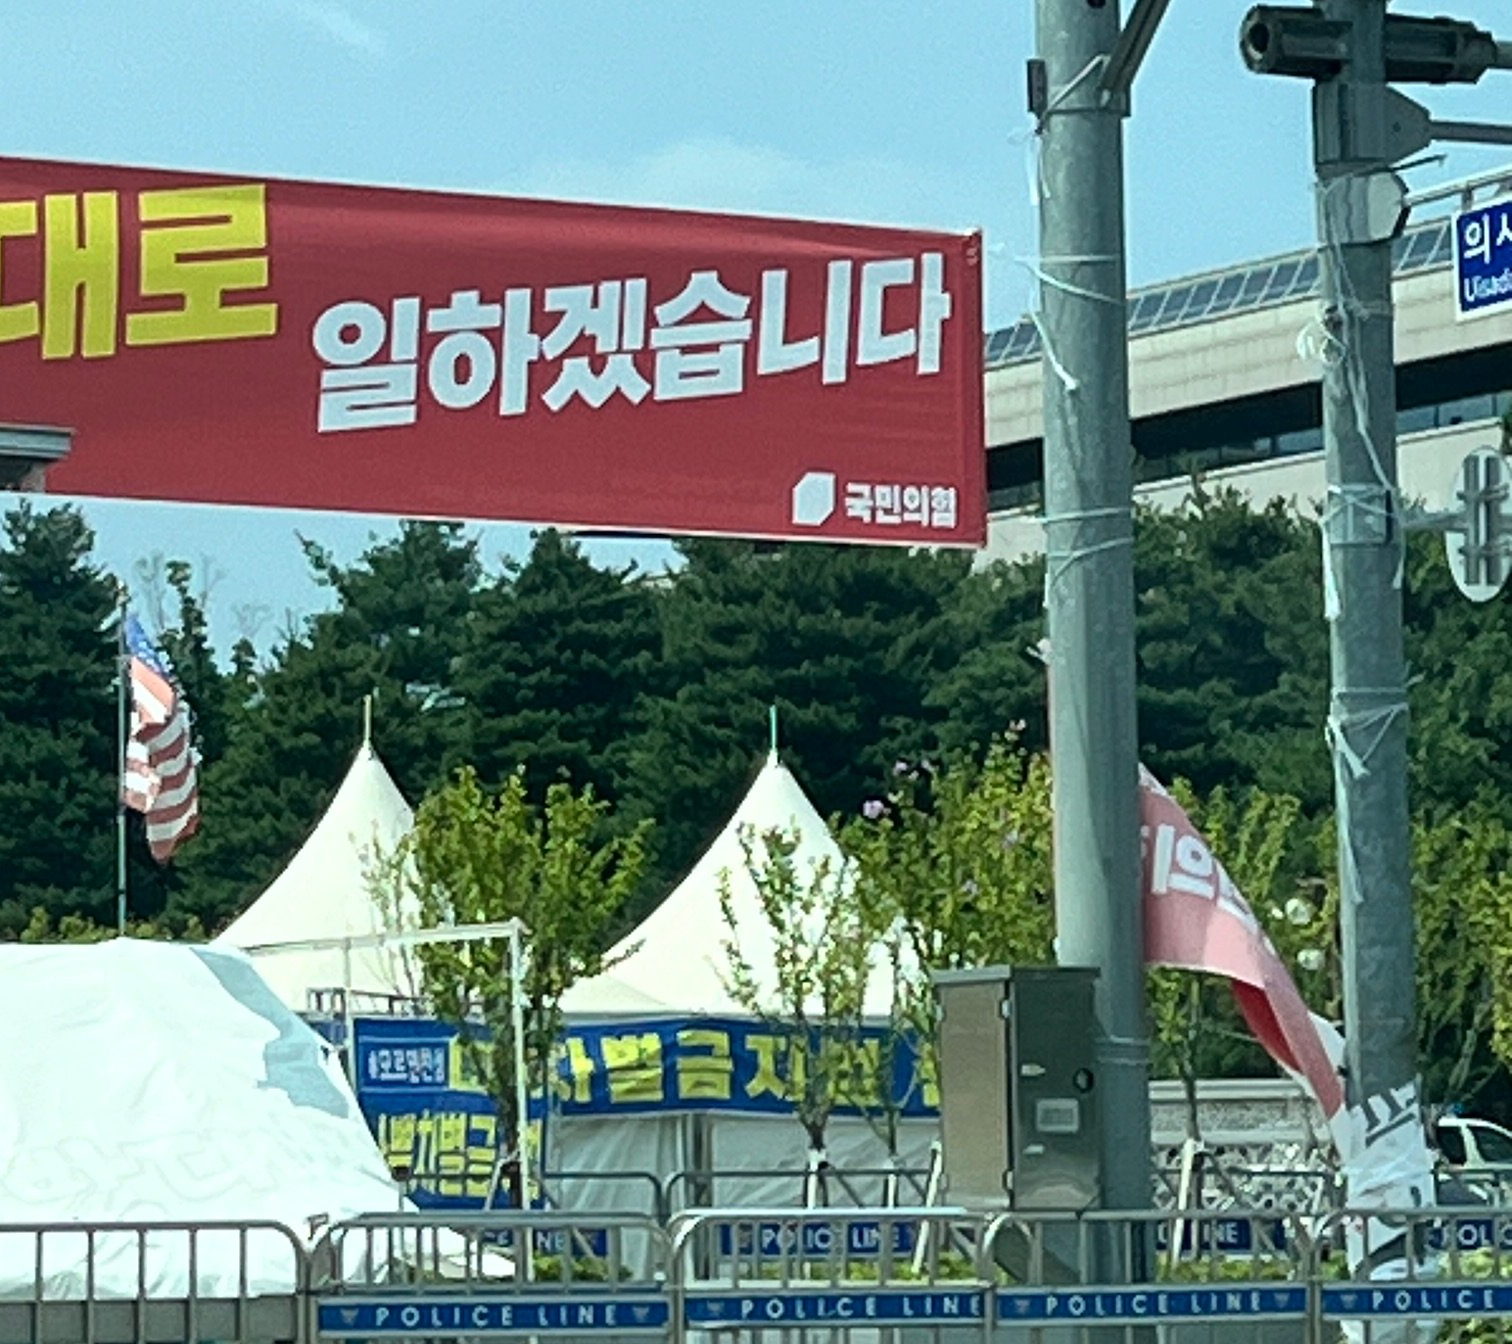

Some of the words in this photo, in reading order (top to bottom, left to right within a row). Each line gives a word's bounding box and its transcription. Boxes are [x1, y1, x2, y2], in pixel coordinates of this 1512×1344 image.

[312, 252, 952, 433] 일하겠습니다
[845, 483, 957, 529] 국민의힘
[741, 1296, 876, 1319] POLICE
[903, 1294, 981, 1318] LINE
[1046, 1291, 1169, 1316] POLICE
[1190, 1290, 1261, 1314] LINE
[1372, 1288, 1495, 1312] POLICE
[375, 1303, 513, 1327] POLICE
[539, 1303, 618, 1325] LINE
